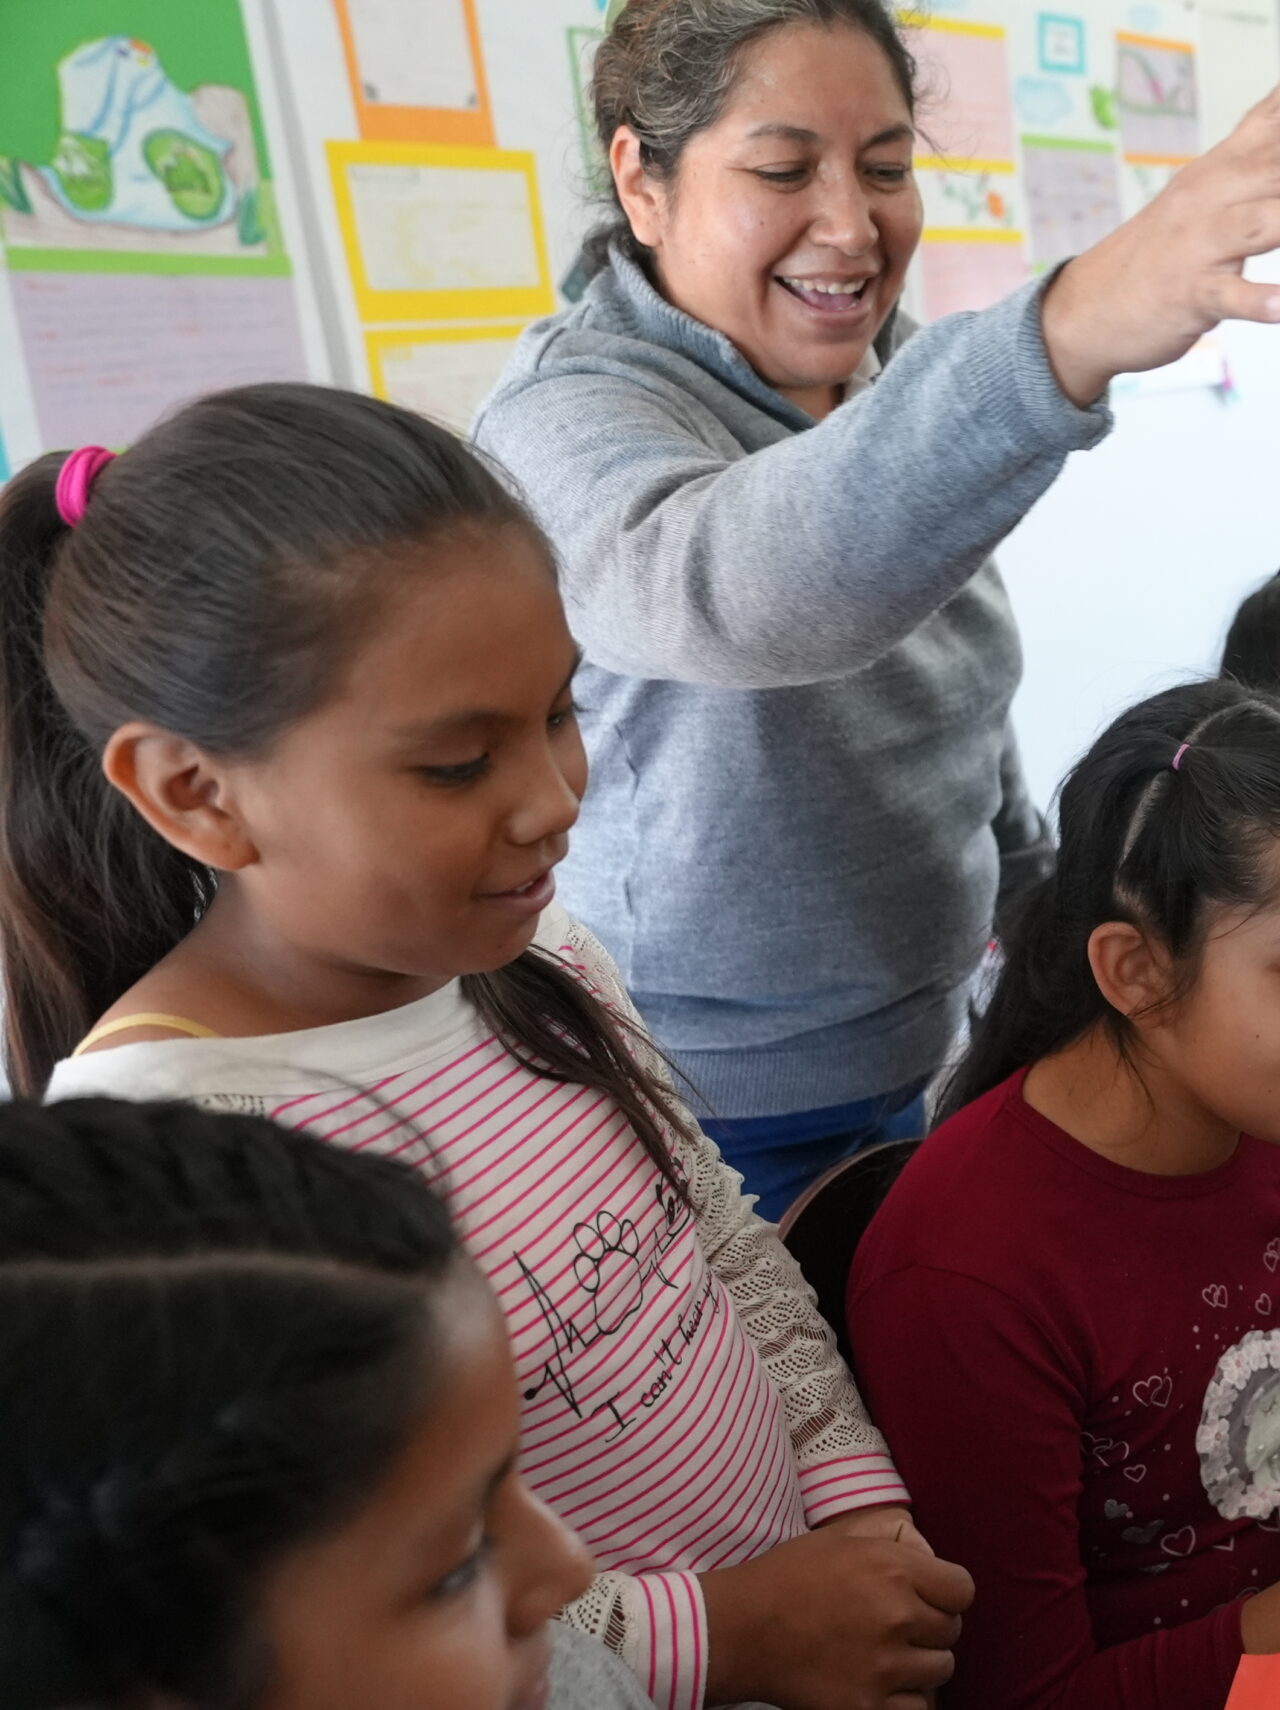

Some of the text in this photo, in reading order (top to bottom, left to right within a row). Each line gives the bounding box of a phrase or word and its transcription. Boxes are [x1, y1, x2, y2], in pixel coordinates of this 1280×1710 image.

[590, 1391, 637, 1443] I
[640, 1338, 682, 1408] can't
[677, 1300, 703, 1346] hear
